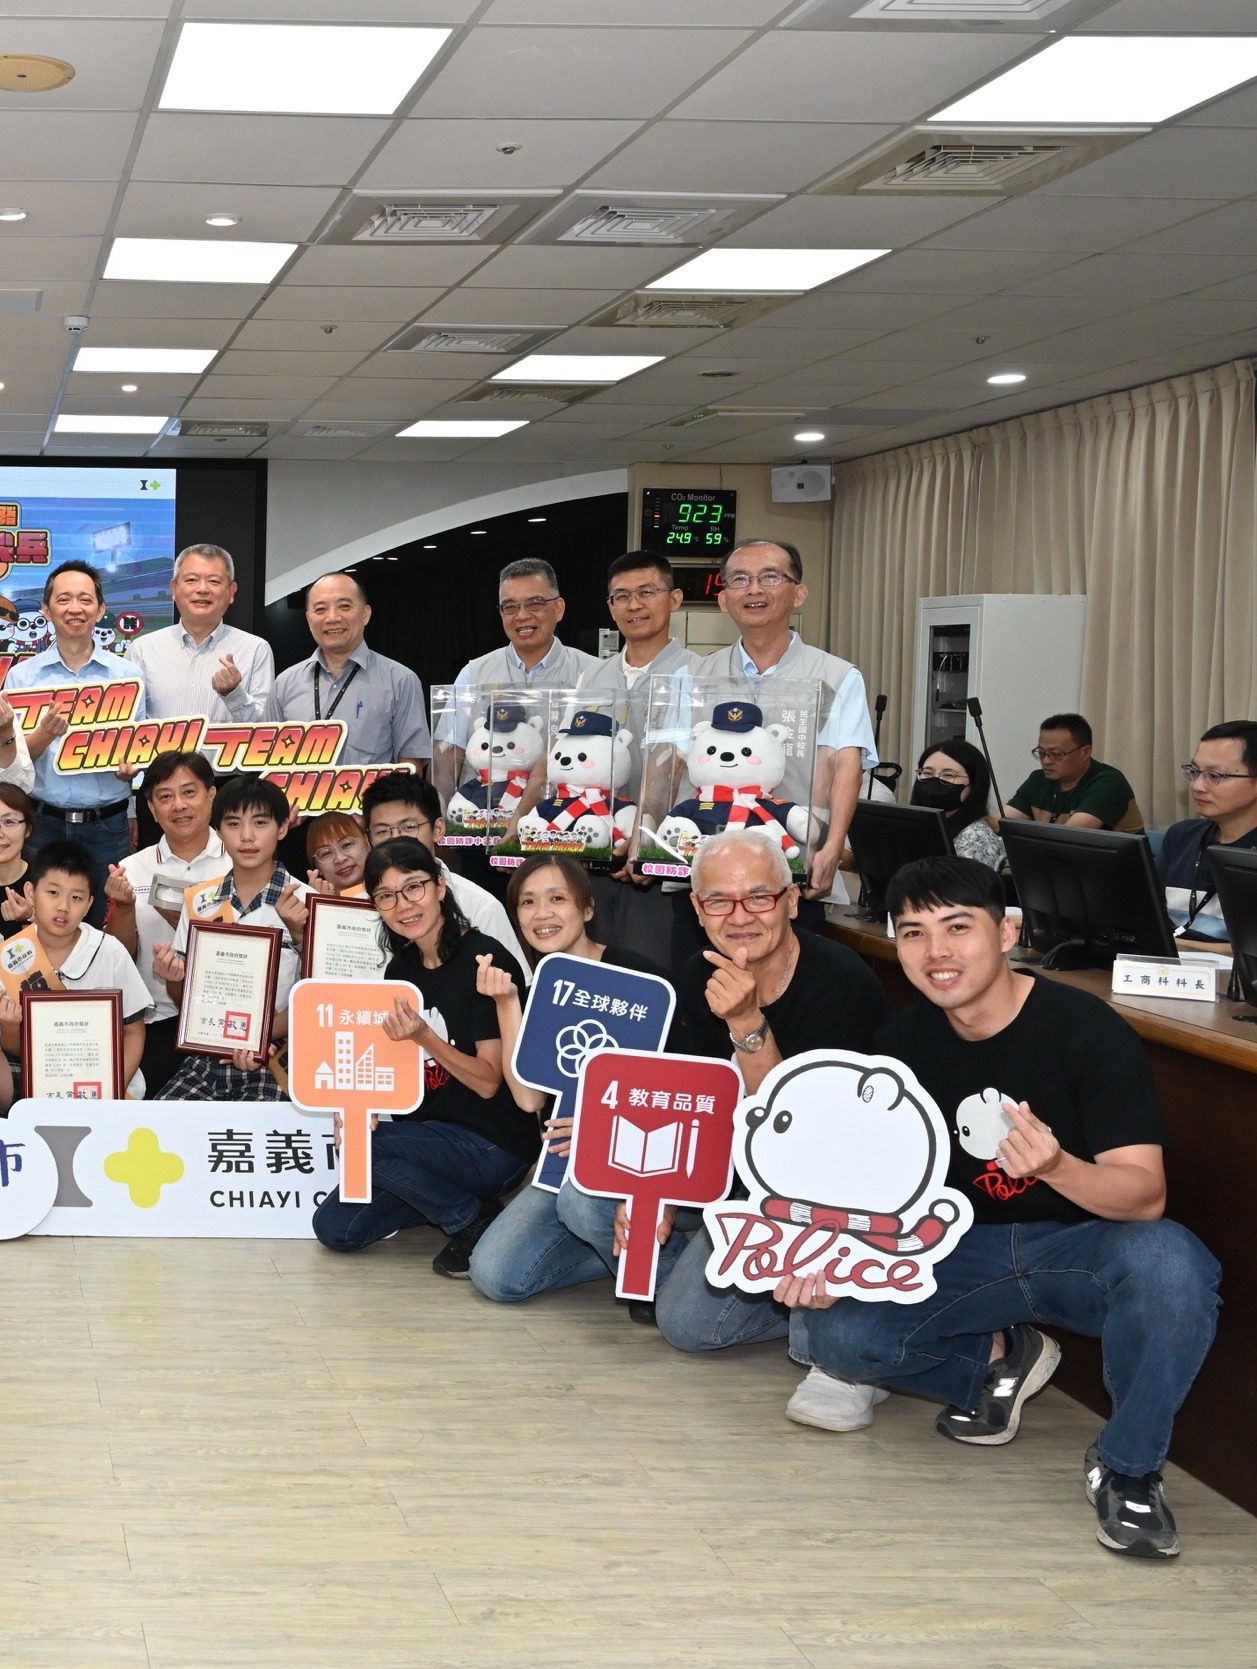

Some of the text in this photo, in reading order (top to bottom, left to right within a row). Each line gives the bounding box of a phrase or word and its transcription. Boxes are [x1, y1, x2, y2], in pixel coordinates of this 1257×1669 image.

[687, 493, 716, 502] Monitor
[678, 504, 722, 523] 923
[705, 533, 722, 544] 59
[57, 719, 204, 771] CHIAYI
[203, 724, 344, 766] TEAM
[553, 979, 574, 1007] 17
[1123, 974, 1205, 990] 工商科科長
[316, 1003, 334, 1028] 11
[575, 988, 647, 1022] 全球夥伴
[601, 1080, 618, 1110] 4
[628, 1087, 716, 1115] 教育品質
[210, 1190, 301, 1208] CHIAYI
[717, 1210, 923, 1292] Police
